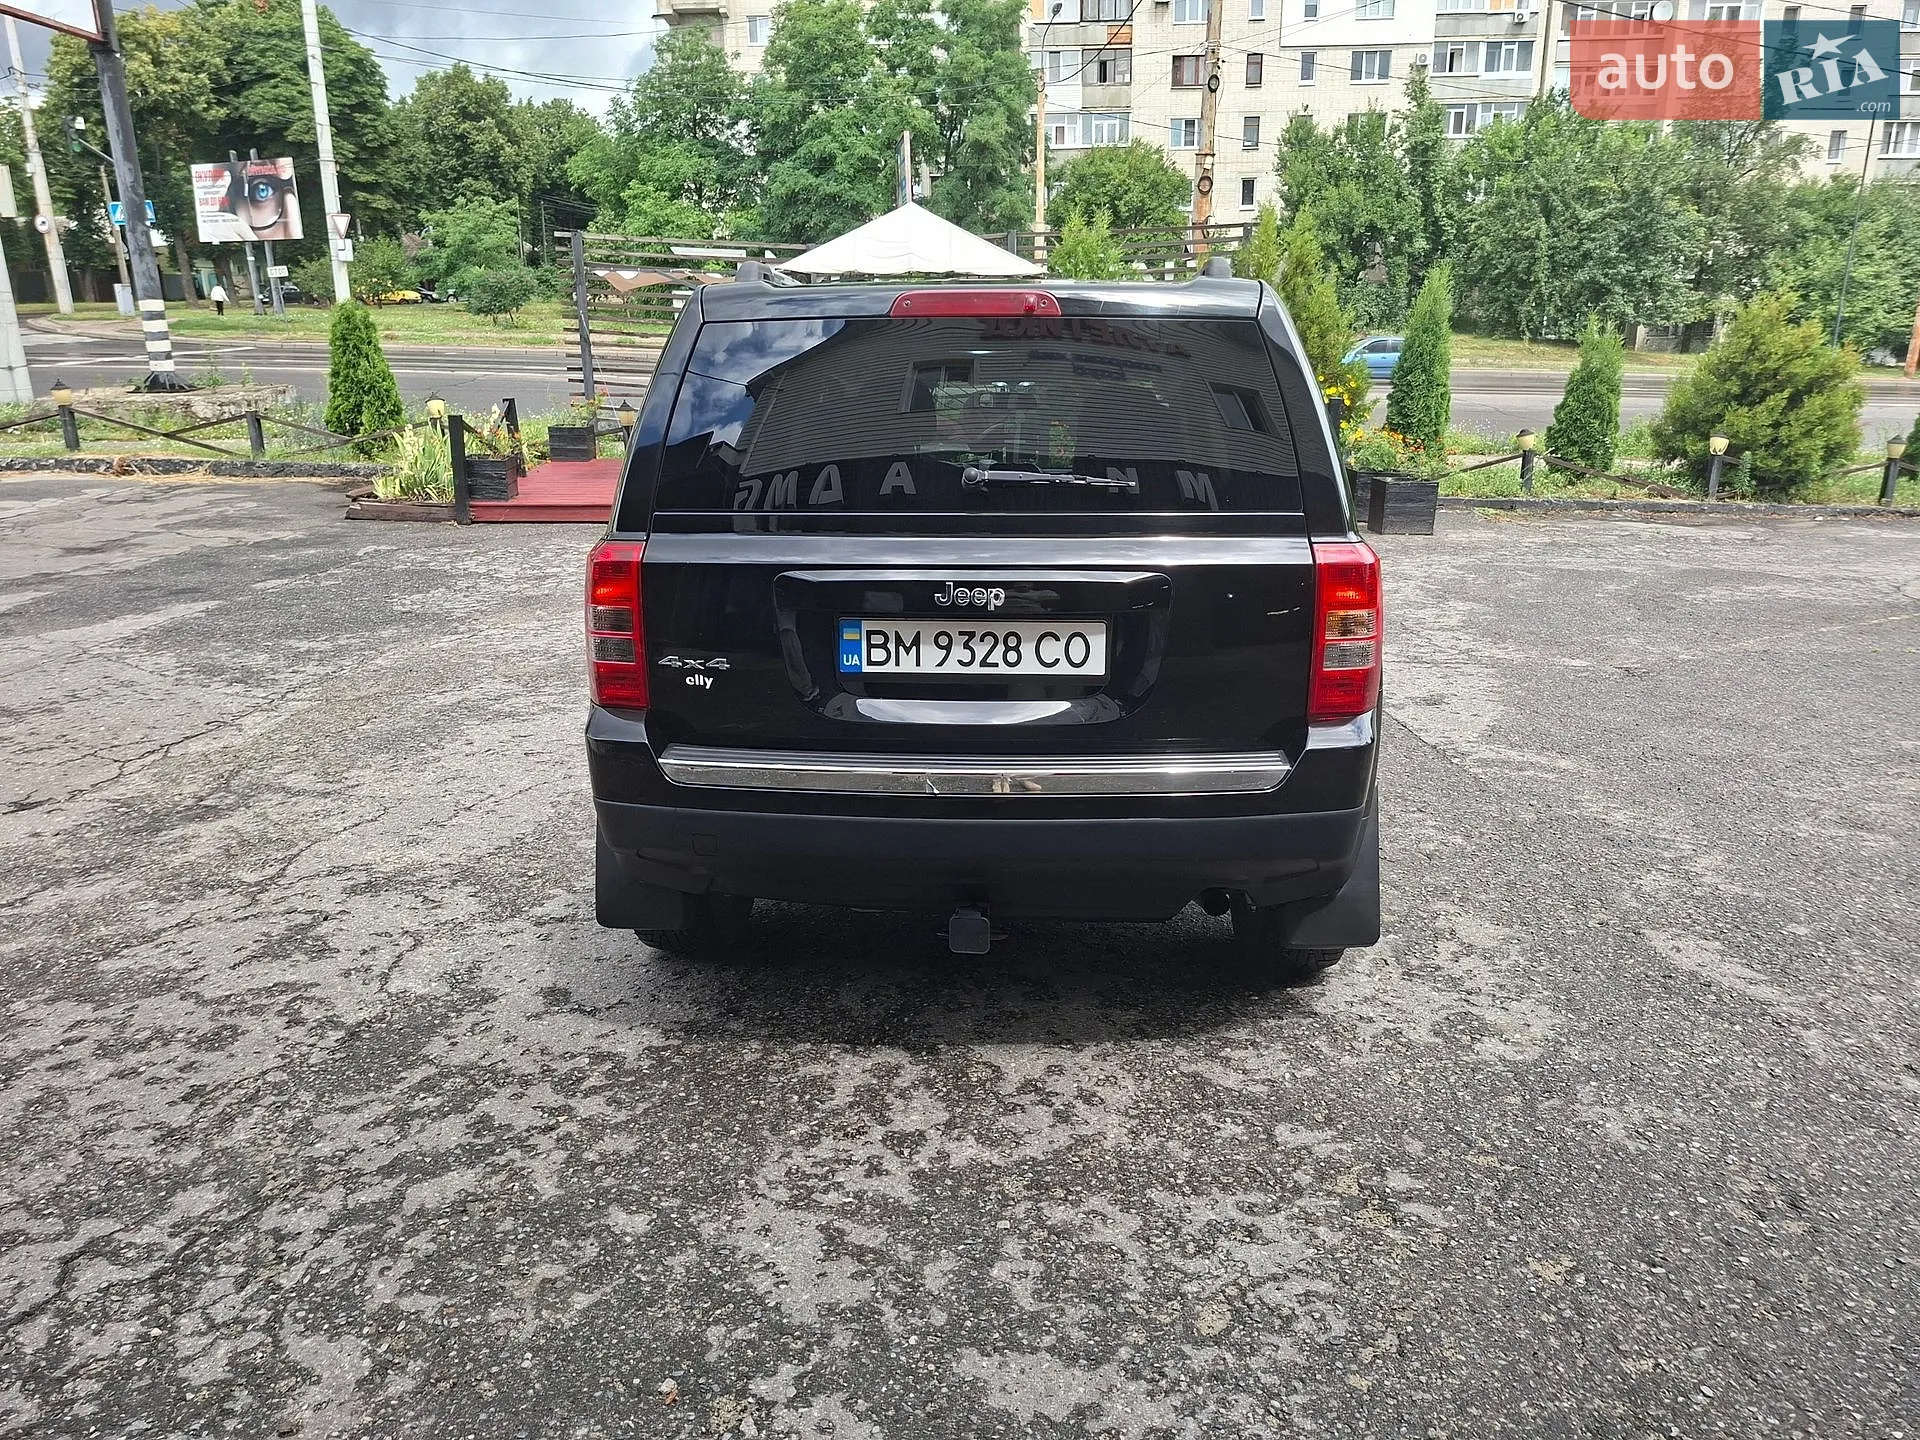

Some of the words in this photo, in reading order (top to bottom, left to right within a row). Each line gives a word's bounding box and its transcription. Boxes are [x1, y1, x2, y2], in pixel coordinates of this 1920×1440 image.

[933, 581, 1006, 611] Jeep
[843, 654, 861, 666] UA
[865, 629, 921, 668] BM
[933, 630, 1023, 668] 9328
[1034, 631, 1091, 669] CO
[657, 655, 731, 670] 4x4
